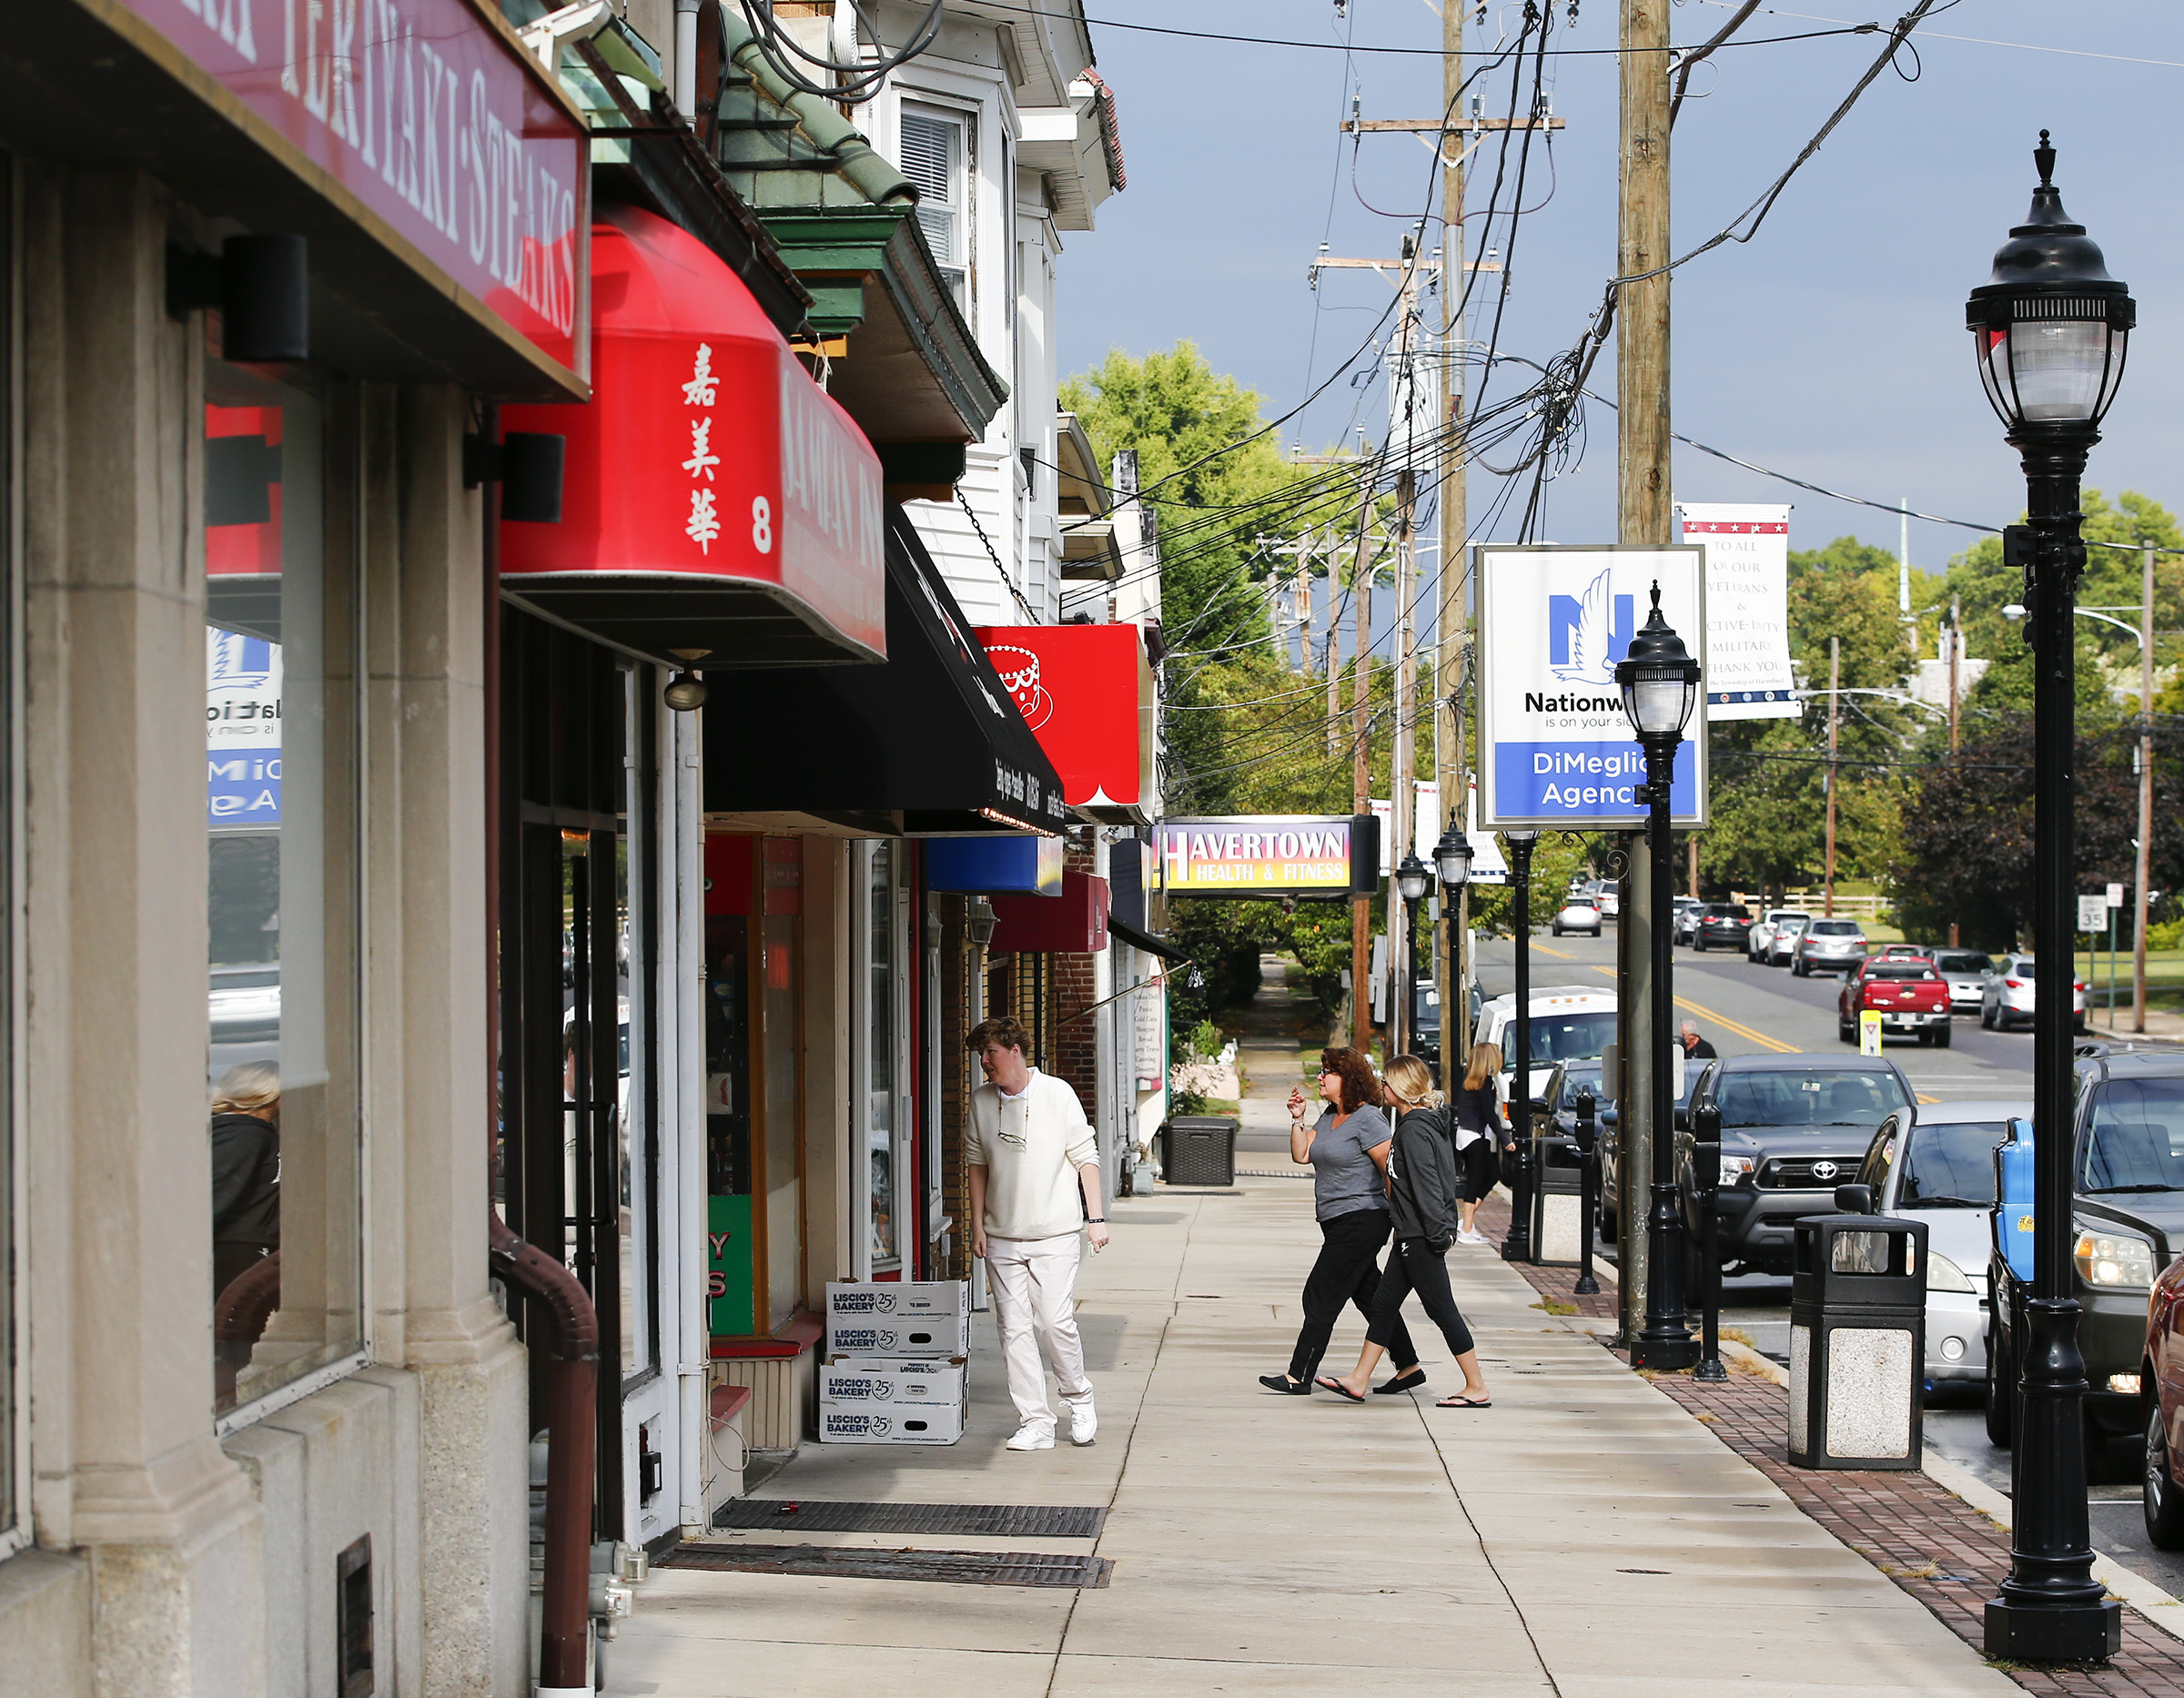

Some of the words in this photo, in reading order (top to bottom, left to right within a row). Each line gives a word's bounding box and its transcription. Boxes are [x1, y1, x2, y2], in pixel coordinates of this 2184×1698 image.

[682, 342, 721, 556] 嘉美華
[752, 496, 772, 554] 8
[1714, 541, 1731, 551] TO
[1734, 541, 1757, 551] ALL
[1732, 561, 1761, 572] OUR
[1707, 581, 1768, 594] VETERANS
[1737, 601, 1746, 611] &
[1706, 621, 1780, 632] CTIVE-DUTY
[1712, 641, 1772, 652] MILITARY
[1706, 662, 1753, 674] THANK
[1756, 661, 1783, 672] YOU
[1525, 692, 1623, 713] Nationw
[1545, 716, 1555, 727] is
[1582, 718, 1612, 729] your
[1158, 831, 1344, 882] HAVERTOWN
[1197, 864, 1255, 882] HEALTH
[1263, 864, 1275, 880] &
[1284, 863, 1345, 880] FITNESS
[2083, 914, 2103, 926] 35
[834, 1293, 875, 1302] LISCIO'S
[834, 1302, 875, 1310] BAKERY
[834, 1329, 876, 1339] LISCIO'S
[835, 1339, 876, 1347] BAKERY
[829, 1378, 871, 1388] LISCIO'S
[829, 1388, 871, 1396] BAKERY
[827, 1414, 869, 1424] LISCIO'S
[827, 1423, 869, 1433] BAKERY
